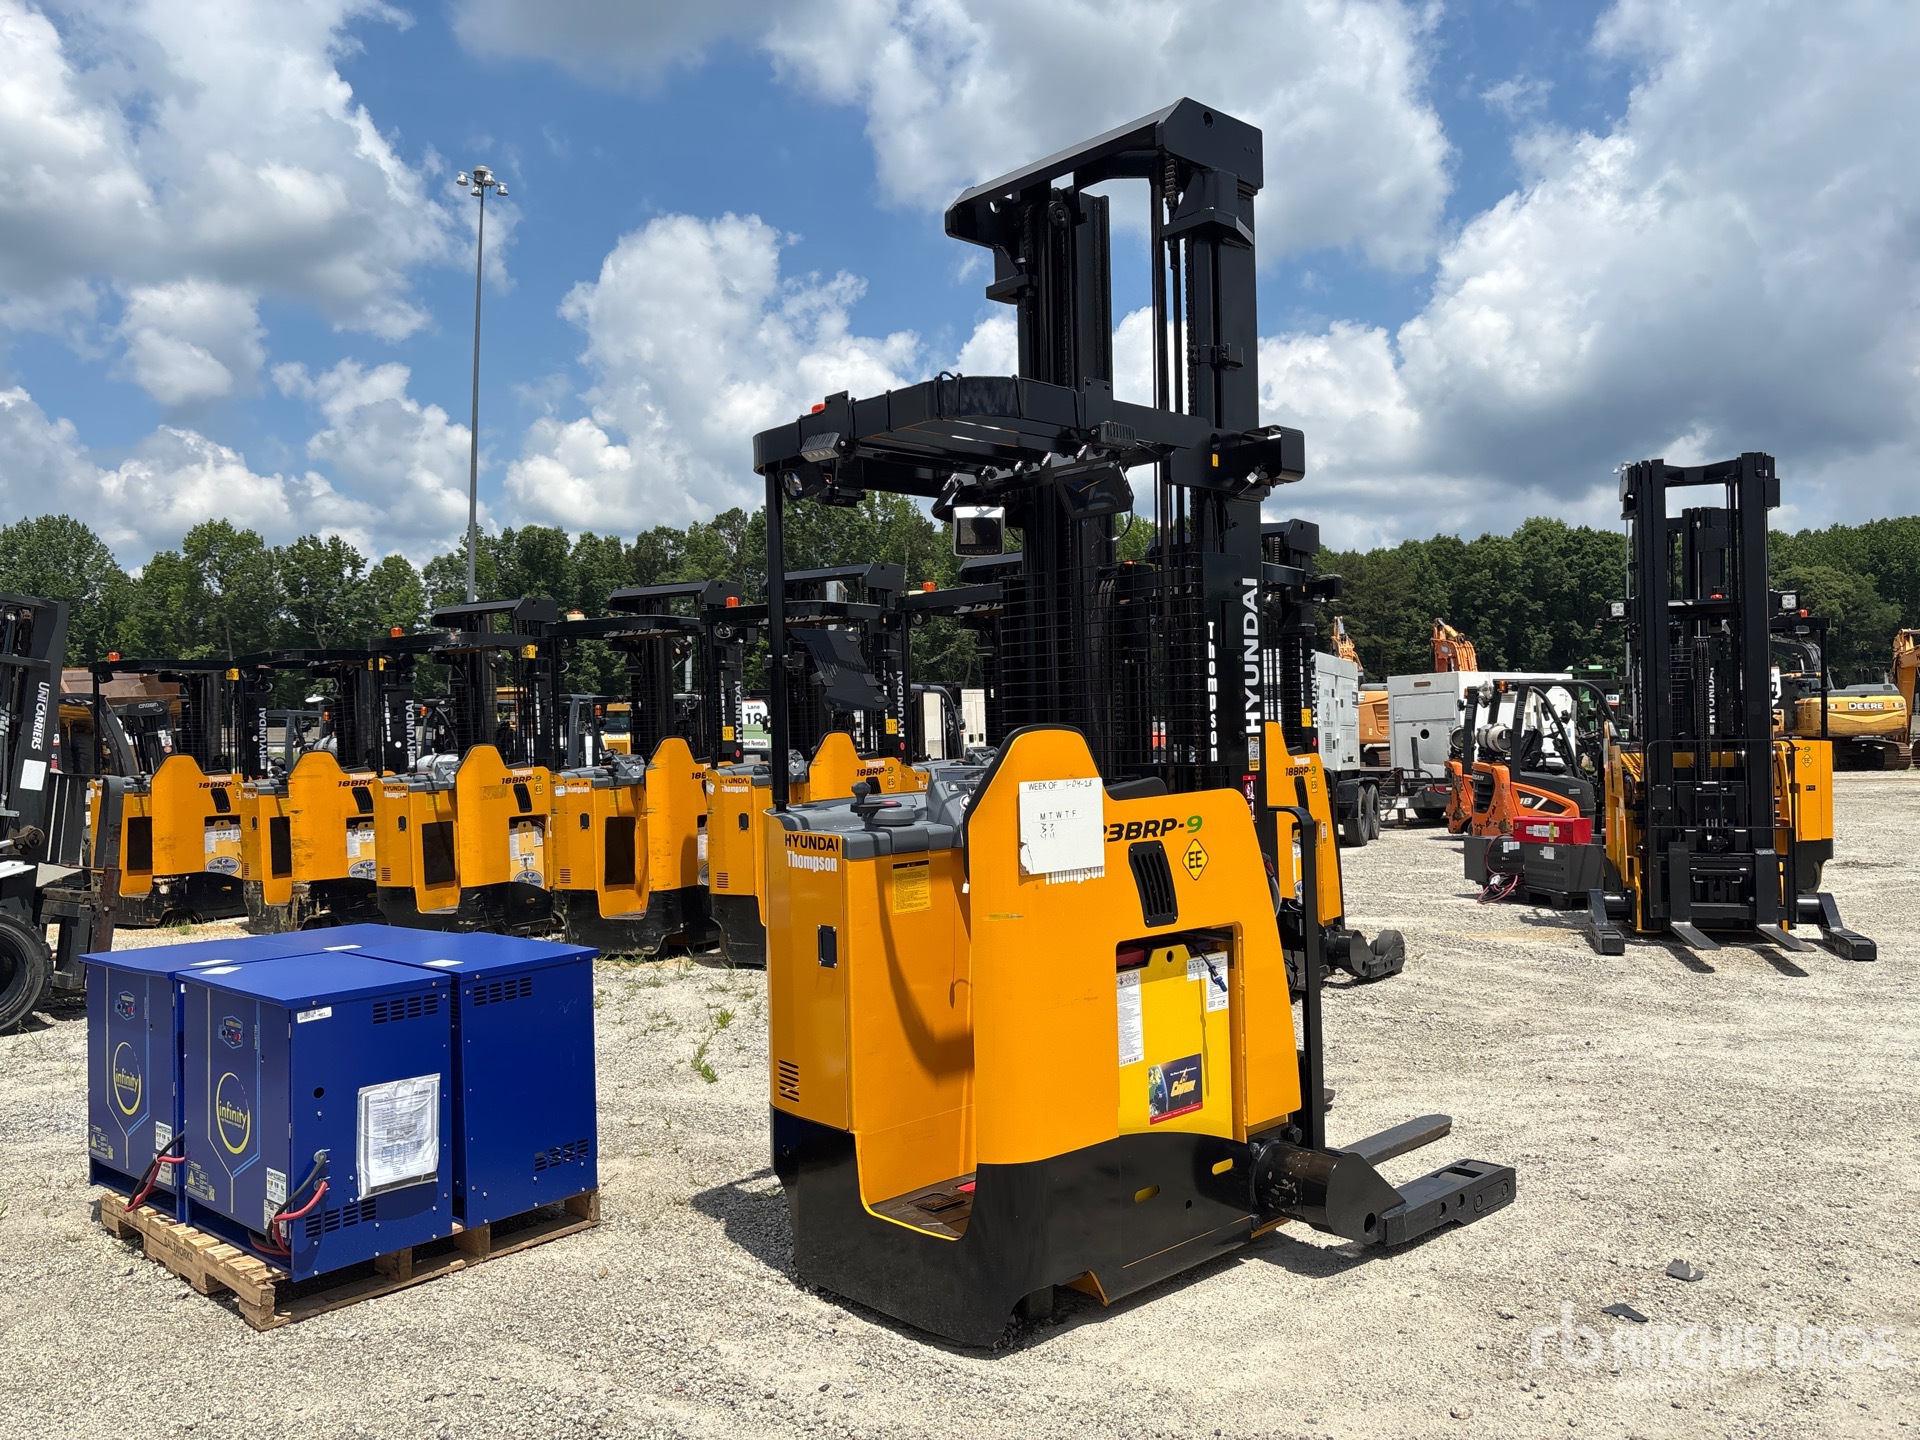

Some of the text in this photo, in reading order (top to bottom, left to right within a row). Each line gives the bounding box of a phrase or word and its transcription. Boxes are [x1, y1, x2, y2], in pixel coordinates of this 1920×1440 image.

[1242, 577, 1261, 733] HYUNDAI
[1207, 621, 1218, 762] Thompson
[734, 681, 743, 743] HYUNDAI
[896, 671, 905, 737] HYUNDAI
[1848, 702, 1884, 710] DEERE
[31, 681, 50, 751] UNICARRIERS
[405, 700, 416, 754] HYUNDAI
[887, 721, 897, 731] 312
[259, 707, 267, 758] HYUNDAI
[723, 728, 734, 739] 313
[501, 775, 542, 785] 18BRP-9
[856, 767, 894, 777] 18BRP-9
[1285, 766, 1317, 776] 18BRP-9
[1028, 781, 1058, 791] WEEK OF
[1056, 811, 1062, 819] W
[1065, 810, 1069, 818] T
[1103, 815, 1203, 843] 3BRP-9
[784, 834, 839, 852] HYUNDAI
[786, 850, 838, 872] Thompson
[1188, 850, 1203, 869] EE
[115, 1068, 139, 1093] infinity
[219, 1101, 248, 1130] infinity
